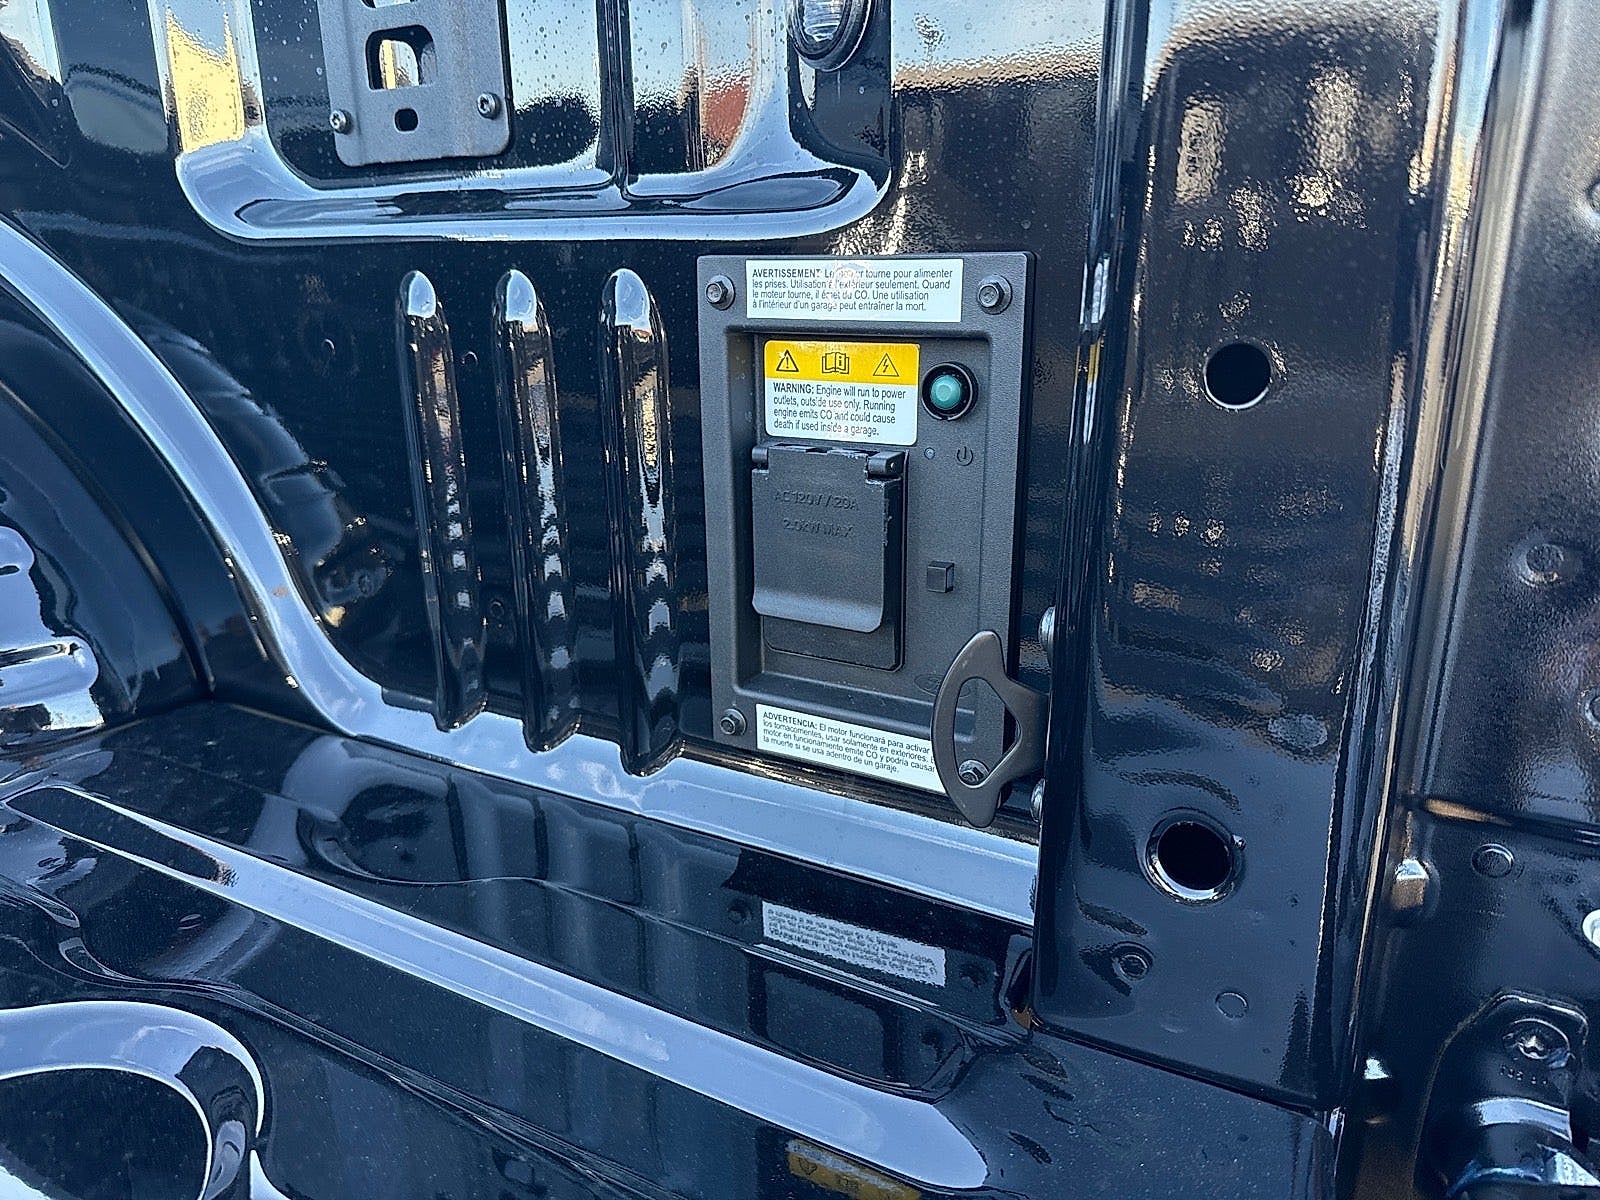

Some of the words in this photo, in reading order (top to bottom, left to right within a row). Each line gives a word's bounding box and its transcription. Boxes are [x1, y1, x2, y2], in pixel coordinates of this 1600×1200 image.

[865, 269, 891, 278] tourne
[894, 270, 912, 280] pour
[914, 268, 953, 278] alimenter
[752, 279, 762, 288] les
[764, 280, 788, 290] prises.
[790, 279, 826, 288] Utilisation
[876, 280, 920, 289] seulement.
[922, 279, 950, 289] Quand
[752, 289, 758, 298] le
[760, 290, 786, 298] moteur
[788, 290, 813, 300] tourne,
[815, 290, 819, 298] il
[854, 290, 870, 300] CO.
[872, 290, 888, 300] Une
[891, 291, 928, 300] utilisation
[752, 300, 757, 308] à
[759, 300, 792, 309] l'intérieur
[794, 300, 809, 309] d'un
[811, 302, 837, 312] garage
[840, 301, 856, 312] peut
[858, 300, 894, 310] entraîner
[896, 301, 902, 310] la
[906, 302, 926, 311] mort.
[773, 382, 814, 394] WARNING:
[816, 384, 842, 398] Engine
[844, 386, 856, 396] will
[858, 388, 870, 398] run
[872, 387, 880, 398] to
[882, 390, 906, 400] power
[774, 395, 798, 406] outlets,
[800, 396, 826, 408] outside
[828, 400, 842, 408] use
[844, 398, 861, 412] only.
[864, 400, 896, 414] Running
[774, 407, 798, 419] engine
[799, 410, 818, 418] emits
[820, 410, 832, 420] CO
[834, 410, 848, 420] and
[850, 412, 870, 422] could
[872, 414, 896, 424] cause
[774, 418, 794, 430] death
[796, 420, 800, 430] if
[802, 422, 818, 431] used
[820, 422, 842, 432] inside
[850, 426, 880, 437] garage.
[763, 711, 817, 730] ADVERTENCIA:
[820, 724, 826, 732] El
[828, 726, 848, 736] motor
[850, 730, 886, 744] funcionará
[888, 740, 904, 748] para
[906, 744, 930, 754] activar
[763, 718, 772, 728] los
[826, 734, 840, 742] usar
[842, 738, 878, 750] solamente
[890, 748, 928, 762] exteriores.
[763, 728, 781, 738] motor
[794, 733, 843, 752] funcionamiento
[844, 746, 864, 756] emite
[866, 750, 878, 759] CO
[880, 754, 884, 762] y
[886, 755, 908, 766] podría
[910, 762, 935, 772] causar
[770, 738, 794, 748] muerte
[802, 744, 810, 752] se
[812, 747, 824, 755] usa
[826, 750, 852, 762] adentro
[854, 755, 862, 764] de
[874, 762, 900, 773] garaje.
